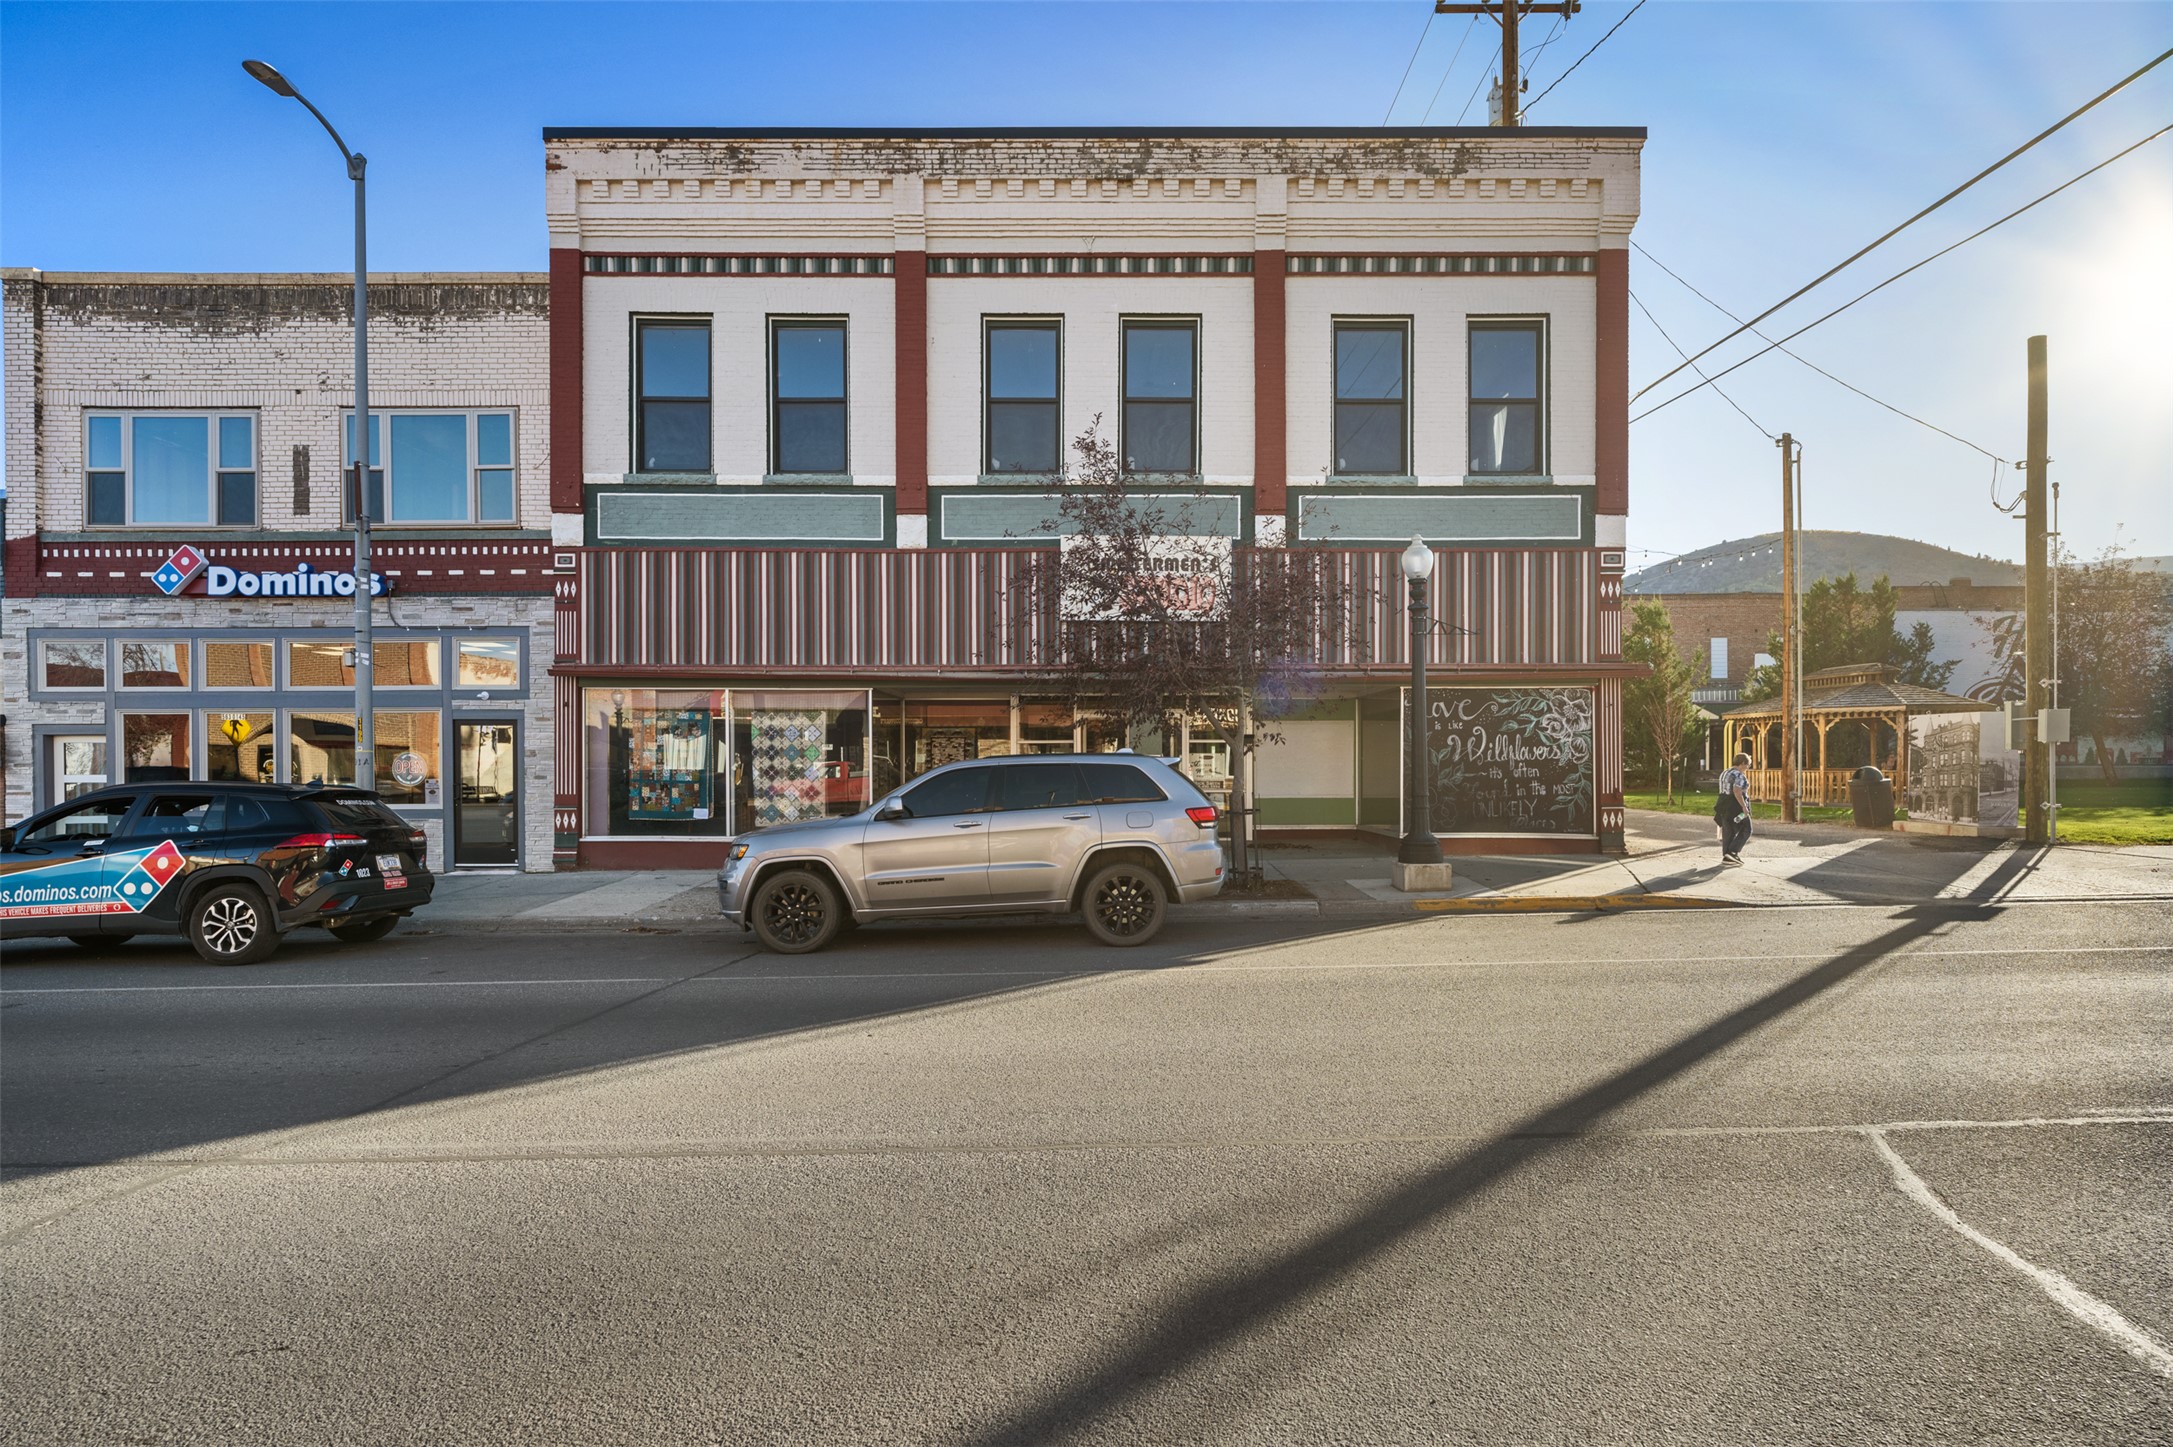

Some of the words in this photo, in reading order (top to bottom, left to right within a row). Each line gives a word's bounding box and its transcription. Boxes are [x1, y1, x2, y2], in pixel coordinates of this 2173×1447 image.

[208, 563, 382, 596] Dominos
[1404, 698, 1499, 721] ove
[1434, 721, 1442, 730] is
[395, 759, 423, 774] OPEN
[1513, 762, 1540, 778] often
[1516, 784, 1526, 796] in
[1530, 780, 1547, 796] the
[1553, 784, 1575, 795] MOST
[1472, 799, 1538, 818] UNLIKELY
[356, 867, 371, 878] 1023
[8, 907, 30, 916] VEHICLE
[30, 906, 49, 915] MAKES
[49, 904, 76, 915] FREQUENT
[77, 904, 107, 912] DELIVERIES
